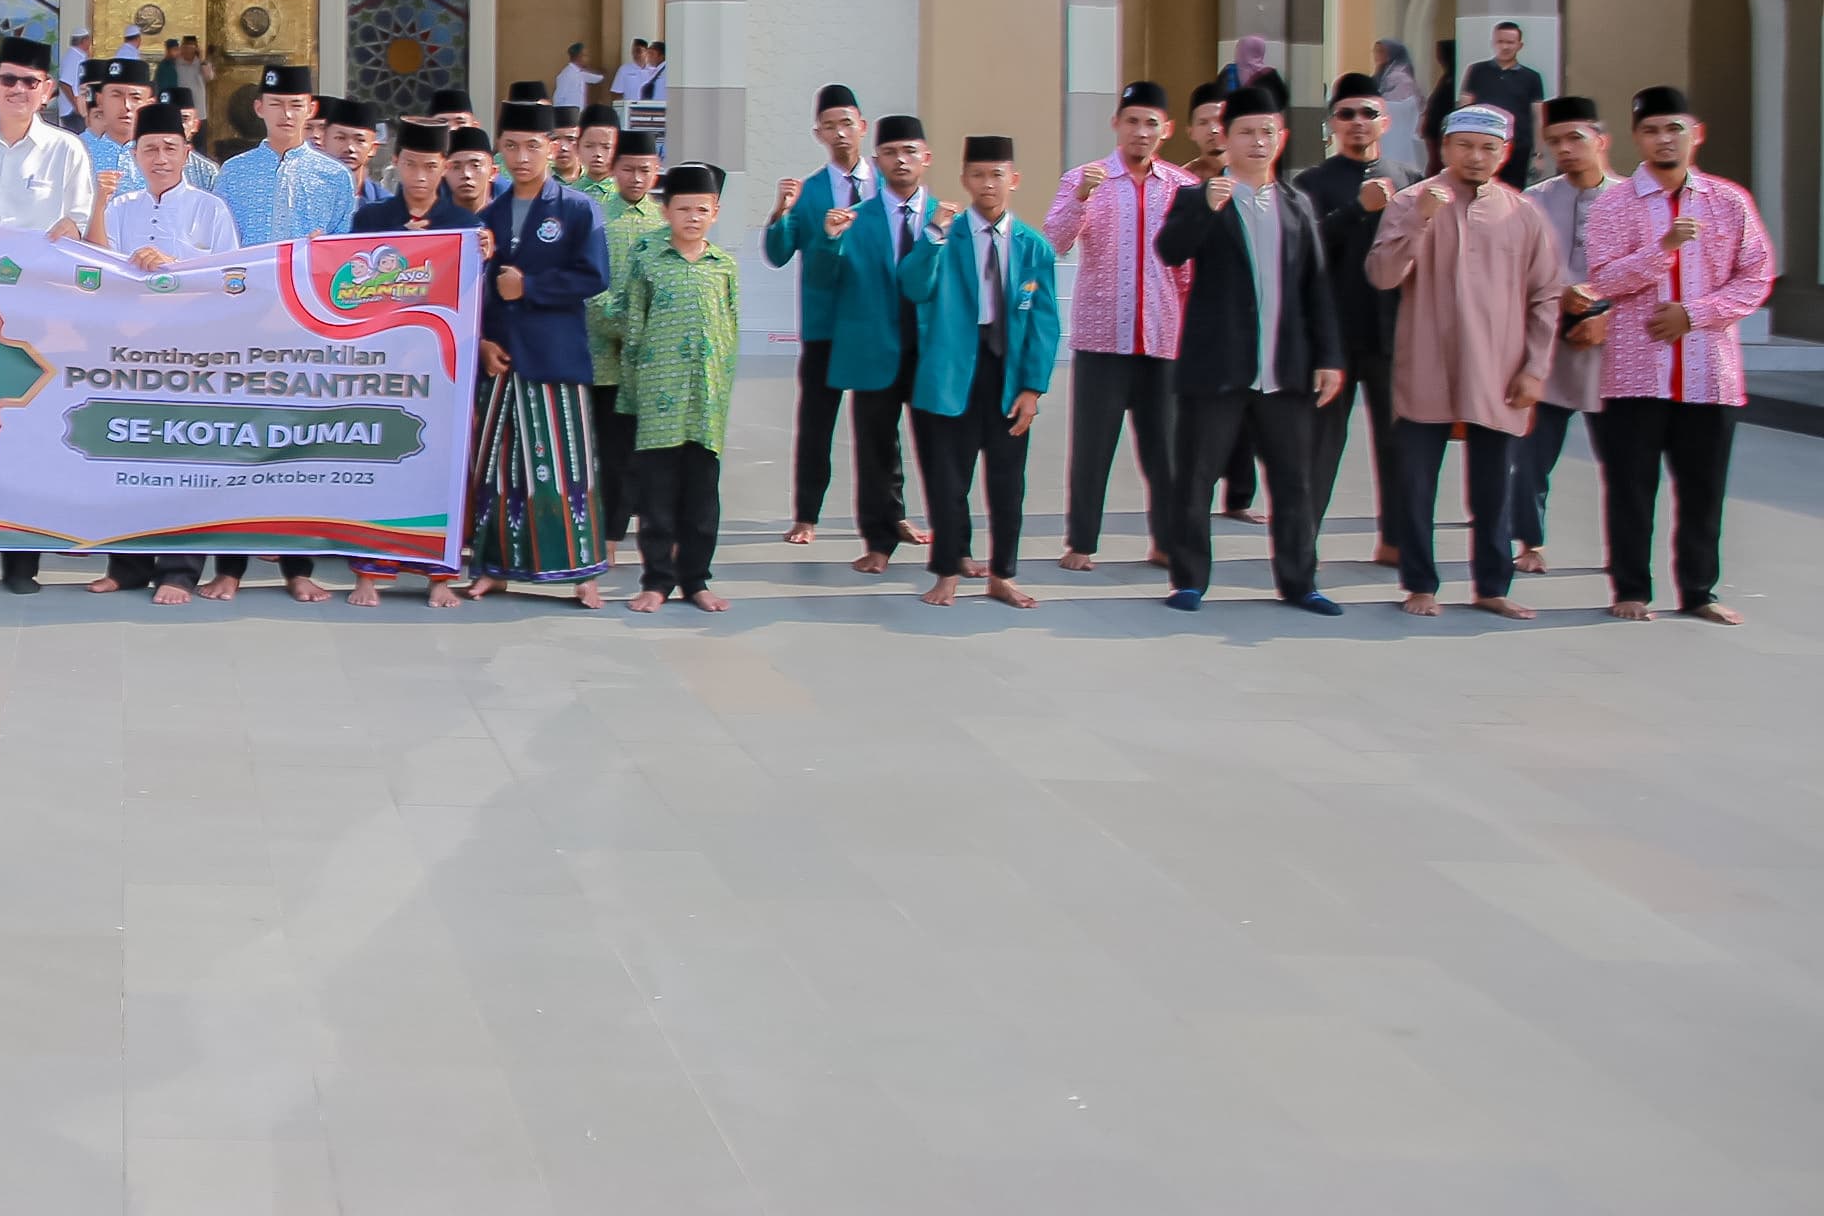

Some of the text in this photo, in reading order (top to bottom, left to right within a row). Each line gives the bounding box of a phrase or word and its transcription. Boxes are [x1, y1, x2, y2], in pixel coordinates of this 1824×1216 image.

[395, 258, 432, 283] Ayo!
[110, 345, 386, 368] Kontingen Perwakilan
[64, 366, 431, 399] PONDOK PESANTREN
[106, 418, 383, 448] SE-KOTA DUMAI
[116, 470, 375, 489] Rokan Hilir, 22 Oktober 2023
